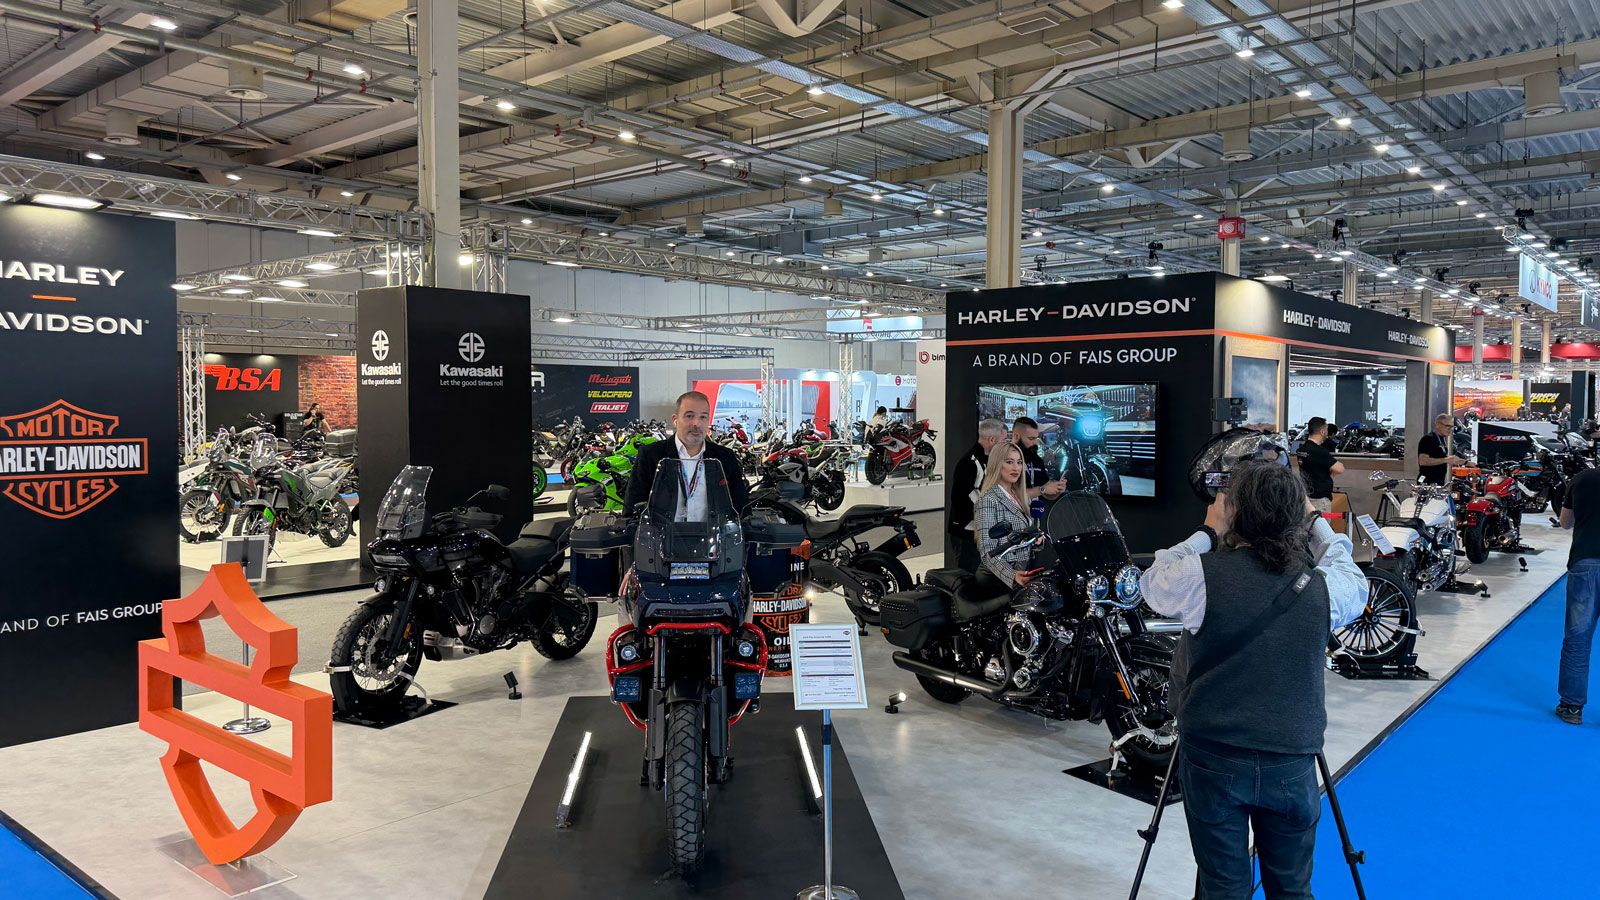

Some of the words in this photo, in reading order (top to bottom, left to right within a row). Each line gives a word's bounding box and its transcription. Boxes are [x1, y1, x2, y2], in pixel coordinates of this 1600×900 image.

[0, 260, 125, 287] ARLEY
[973, 355, 982, 367] A
[988, 353, 1043, 367] BRAND
[1050, 352, 1072, 365] OF
[1079, 350, 1112, 364] FAIS
[1117, 348, 1178, 363] GROUP
[216, 368, 281, 391] BSA
[361, 363, 401, 376] Kawasaki
[440, 364, 503, 377] Kawasaki
[588, 374, 632, 386] Malaguti
[17, 407, 105, 437] MOTOR
[18, 478, 106, 512] CYCLES
[46, 613, 70, 628] OF
[77, 609, 109, 624] FAIS
[112, 602, 163, 619] GROUP
[774, 637, 790, 646] OIL
